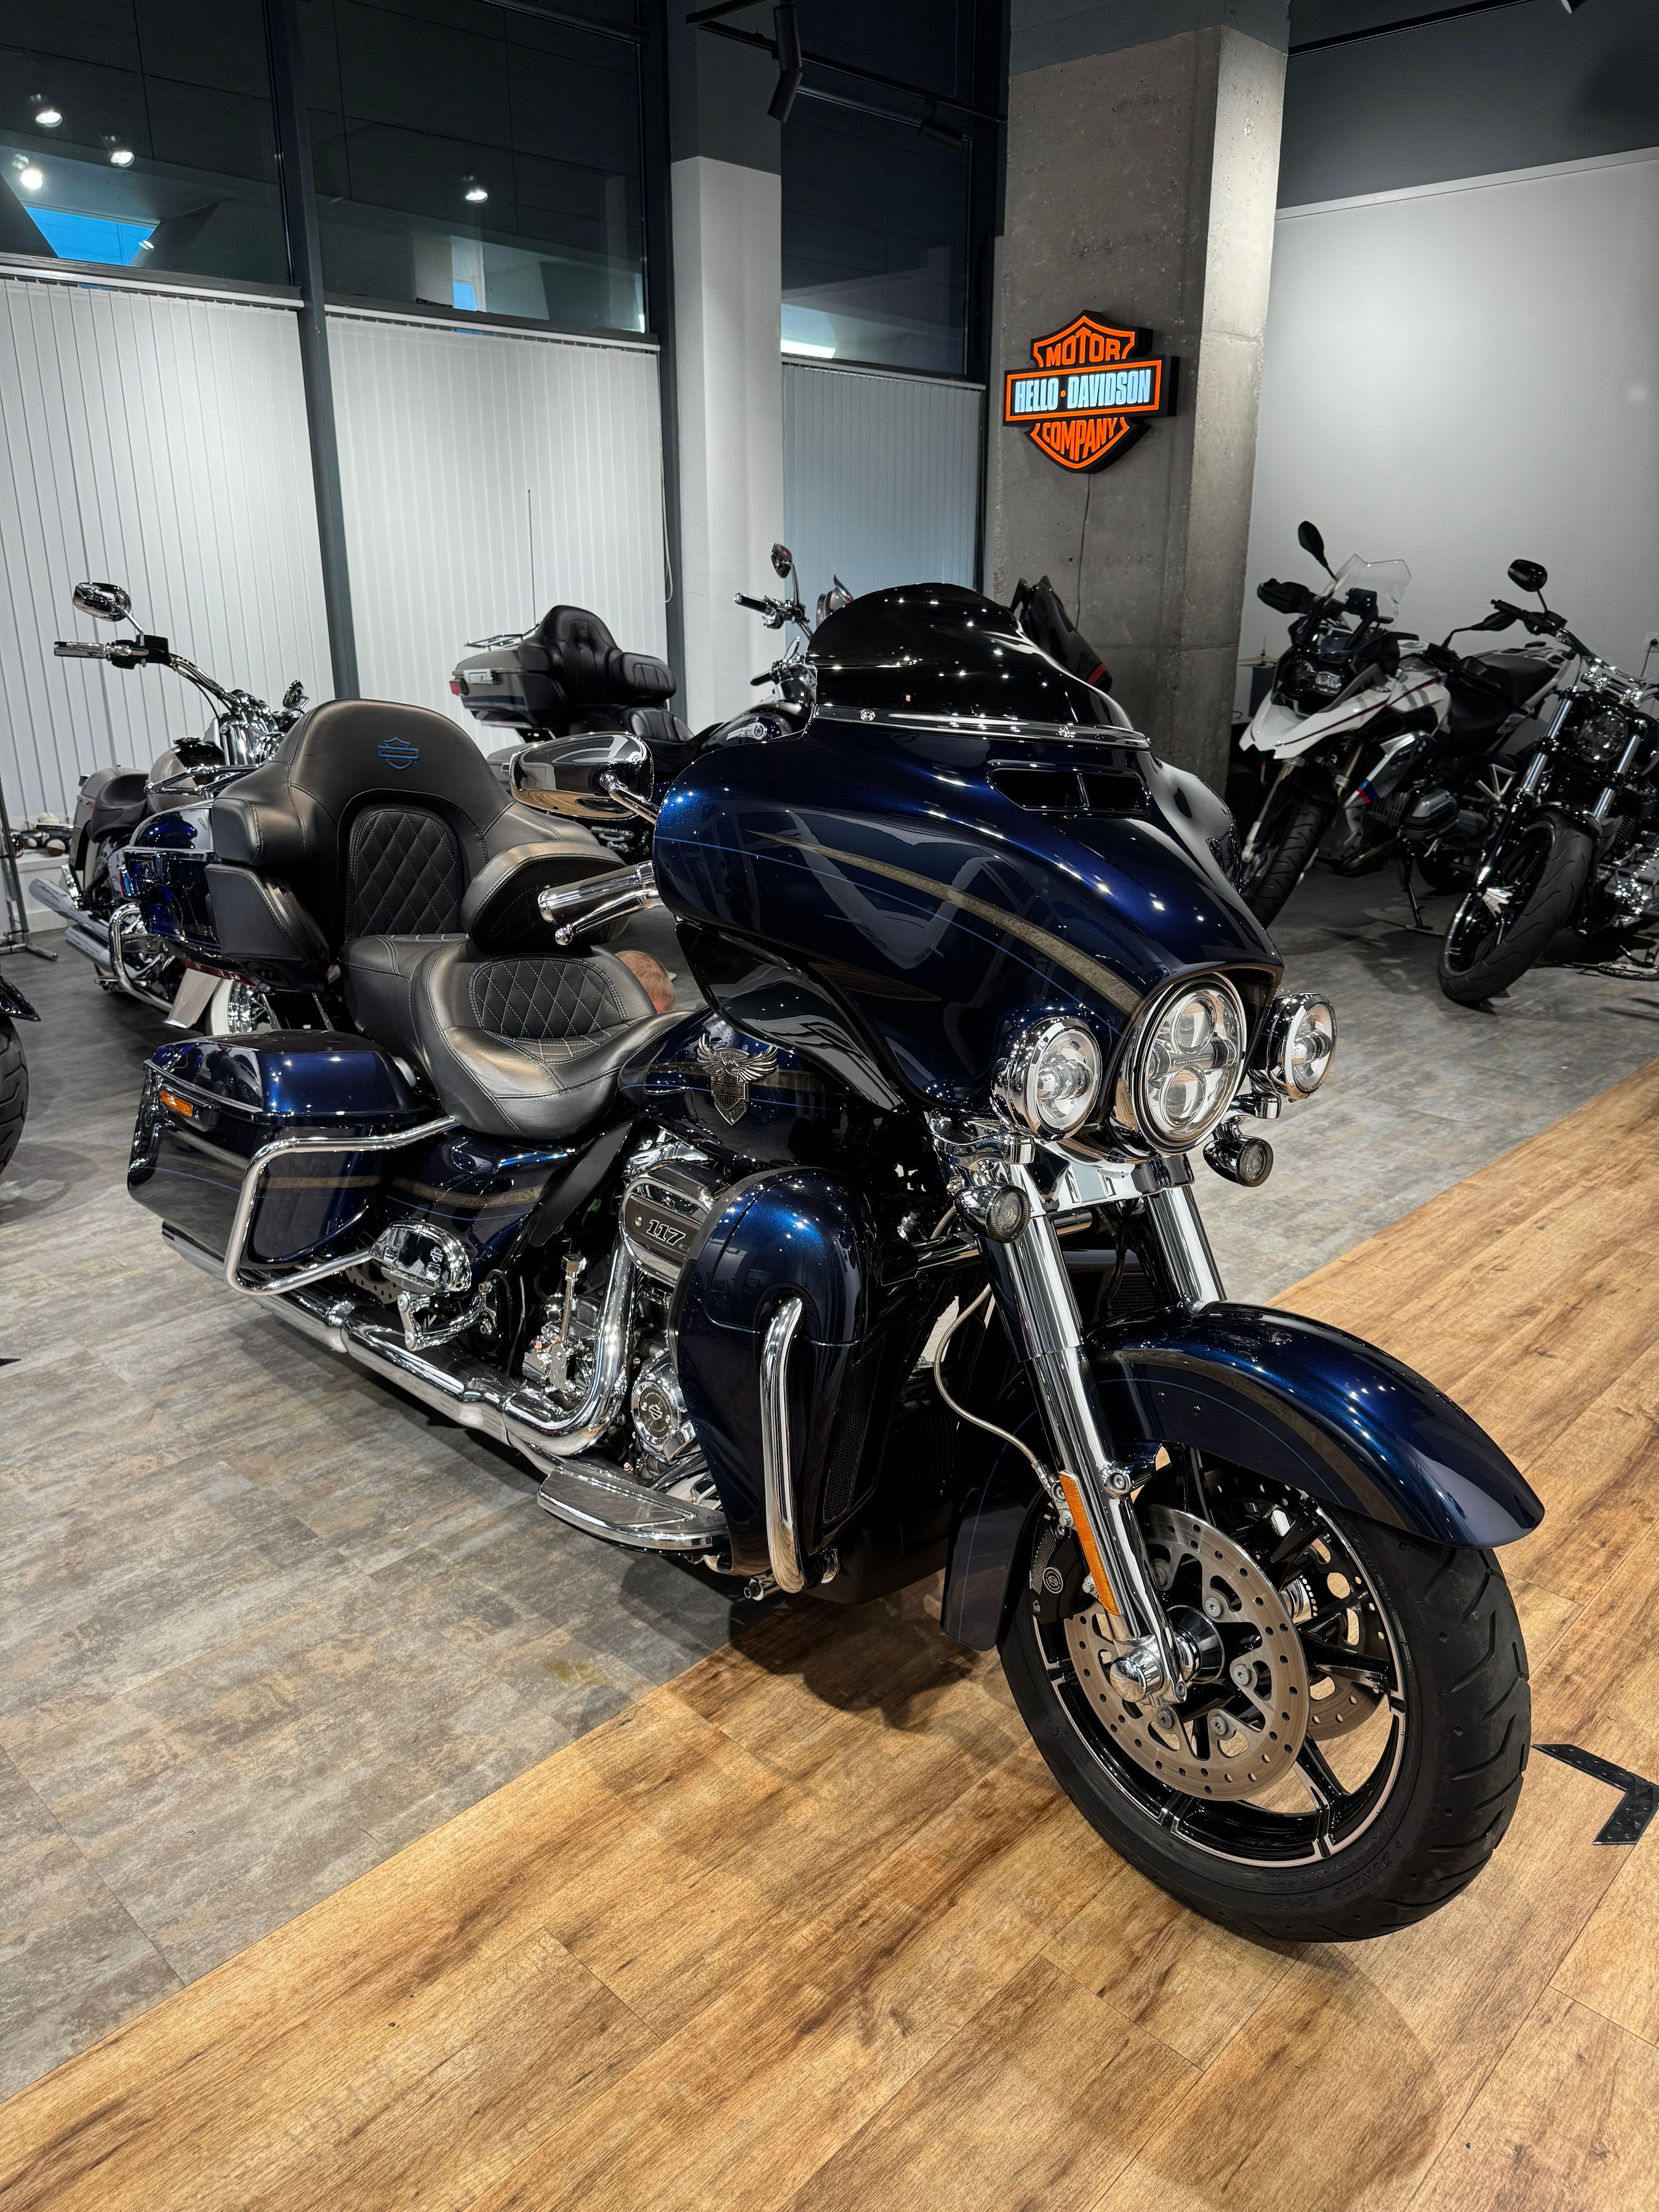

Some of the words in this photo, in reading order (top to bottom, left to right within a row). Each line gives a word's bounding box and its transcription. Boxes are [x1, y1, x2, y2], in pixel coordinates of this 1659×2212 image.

[1046, 327, 1120, 367] MOTOR
[1042, 417, 1118, 461] COMPANY
[646, 1219, 686, 1246] 117
[1332, 1852, 1391, 1901] DUNLOP
[1262, 1895, 1318, 1909] D408F
